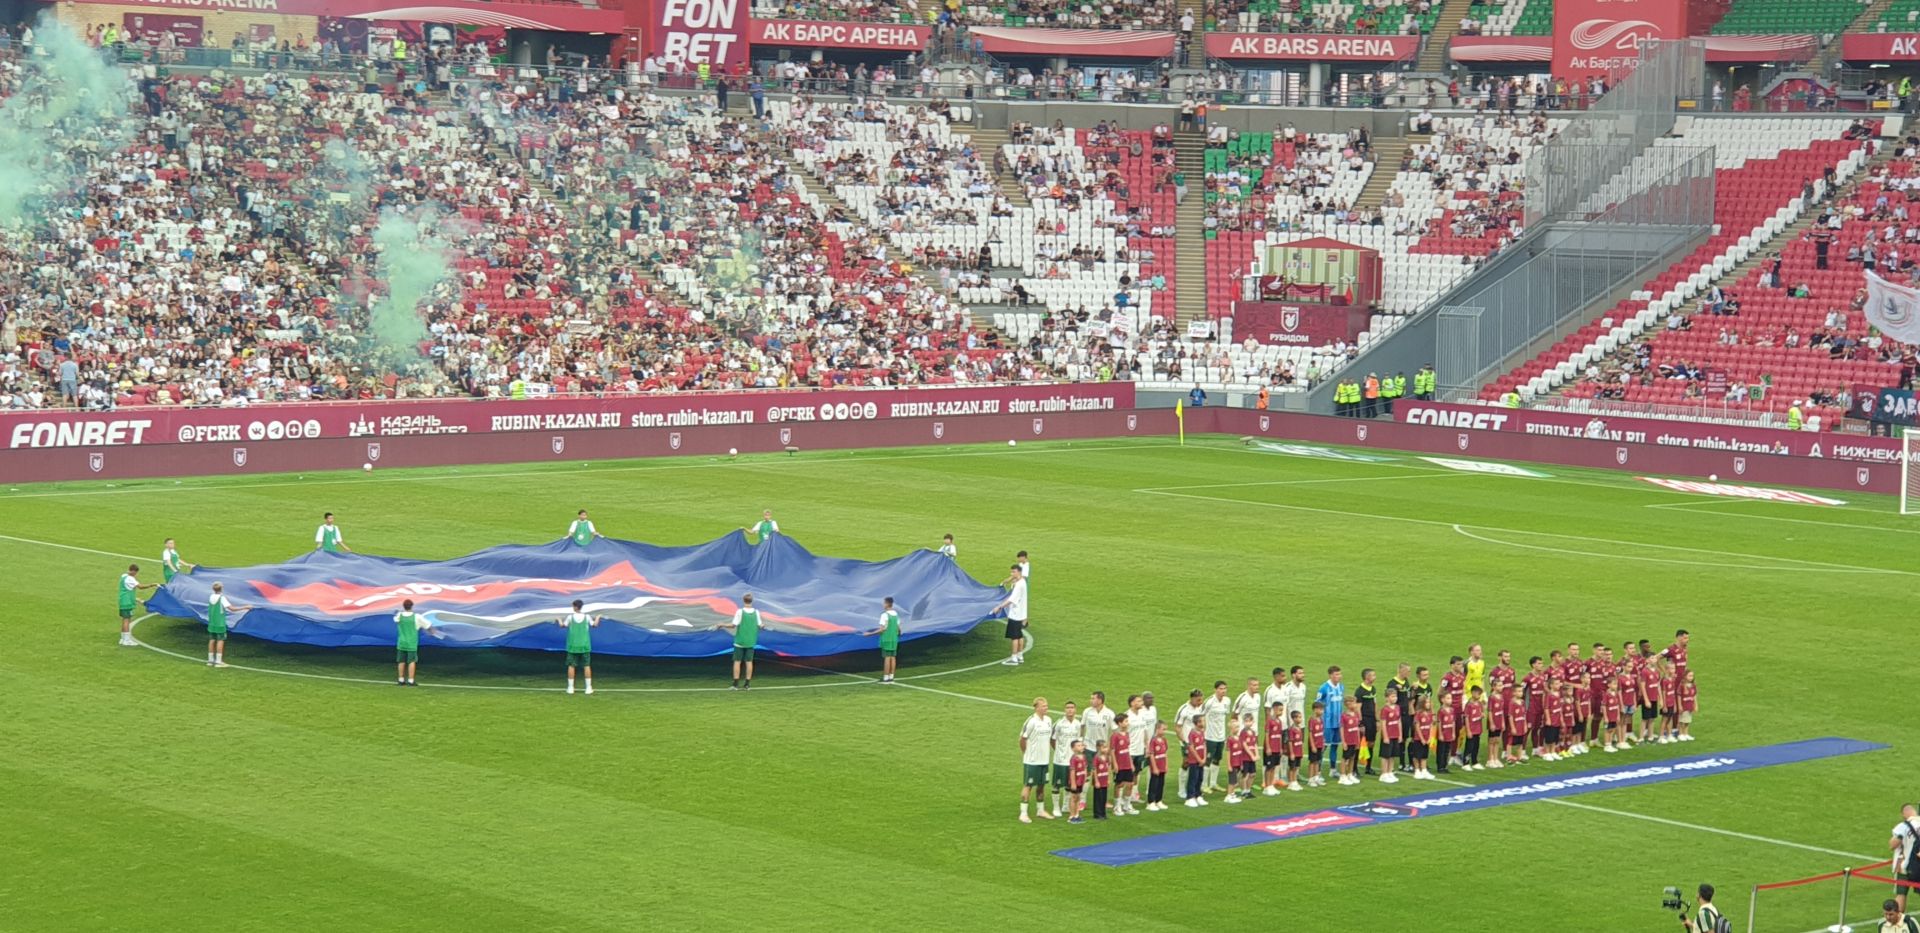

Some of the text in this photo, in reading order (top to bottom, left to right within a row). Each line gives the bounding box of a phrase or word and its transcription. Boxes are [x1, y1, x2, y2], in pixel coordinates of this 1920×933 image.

[662, 0, 738, 29] FON
[763, 22, 918, 46] АК БАРС АРЕНА
[665, 31, 738, 65] BET
[1230, 37, 1394, 56] AK BARS ARENA
[1569, 57, 1587, 68] Ак
[1589, 56, 1620, 70] Барс
[1270, 333, 1309, 343] РУБИДОМ
[767, 406, 816, 422] @FCRK
[890, 399, 1000, 417] RUBIN-KAZAN.RU
[1008, 395, 1114, 414] store.rubin-kazan.ru
[380, 415, 441, 428] КАЗАНЬ
[491, 412, 622, 431] RUBIN-KAZAN.RU
[631, 408, 754, 428] store.rubin-kazan.ru
[1406, 407, 1508, 430] FONBET
[10, 419, 152, 448] FONBET
[178, 424, 242, 442] @FCRK
[1525, 422, 1646, 443] RUBIN-KANRU
